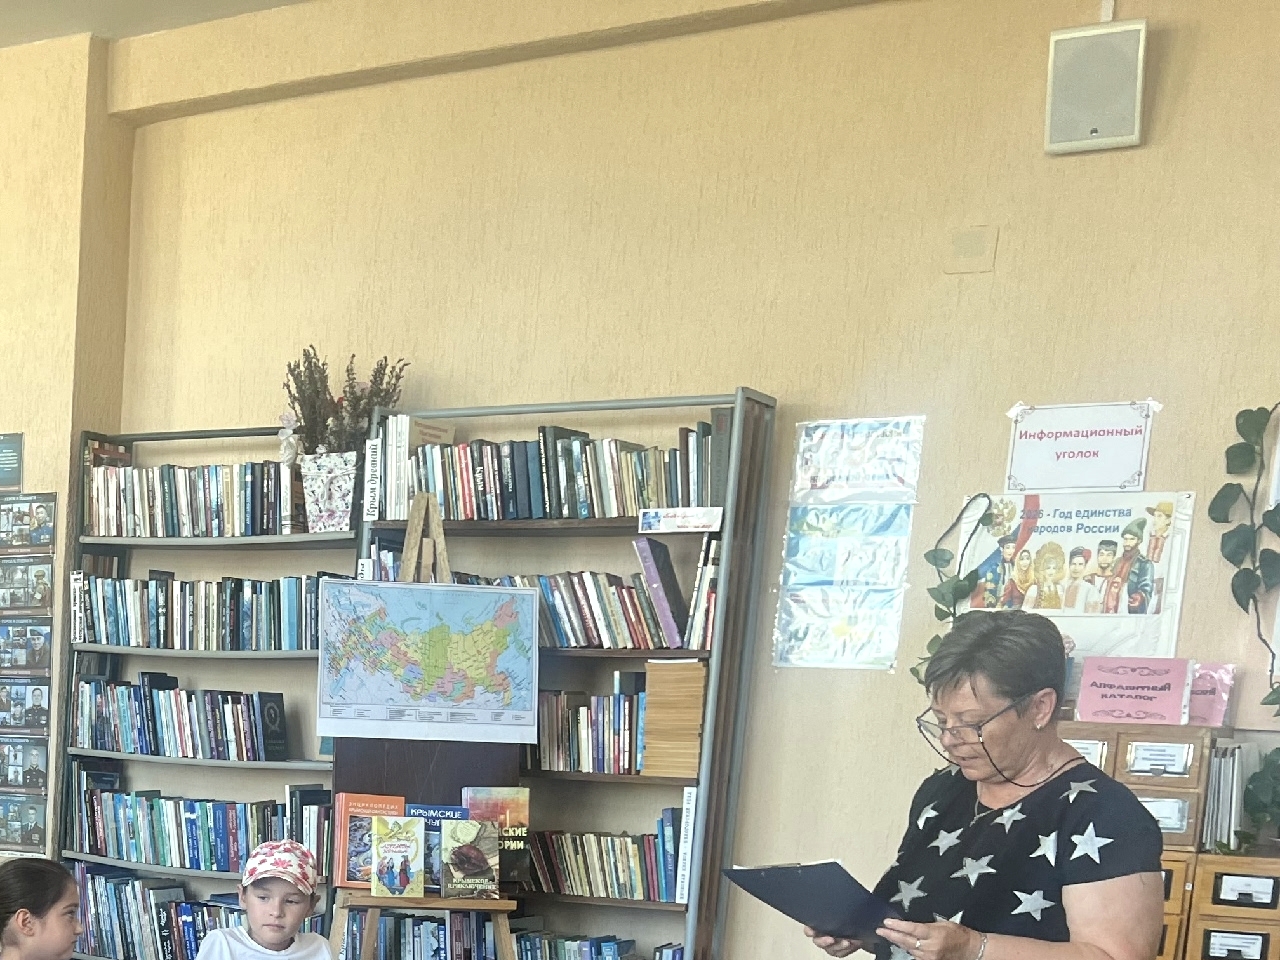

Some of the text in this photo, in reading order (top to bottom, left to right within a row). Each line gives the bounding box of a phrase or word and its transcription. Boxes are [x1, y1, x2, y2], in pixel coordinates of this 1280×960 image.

[1019, 425, 1143, 441] Информационный
[1055, 450, 1099, 461] уголок
[366, 486, 378, 517] Крым
[1053, 508, 1073, 520] Год
[1075, 507, 1132, 521] единства
[1075, 522, 1120, 534] России
[1101, 693, 1157, 701] КАТАЛОГ
[499, 827, 528, 837] СКИЕ
[498, 840, 525, 850] ОРИИ
